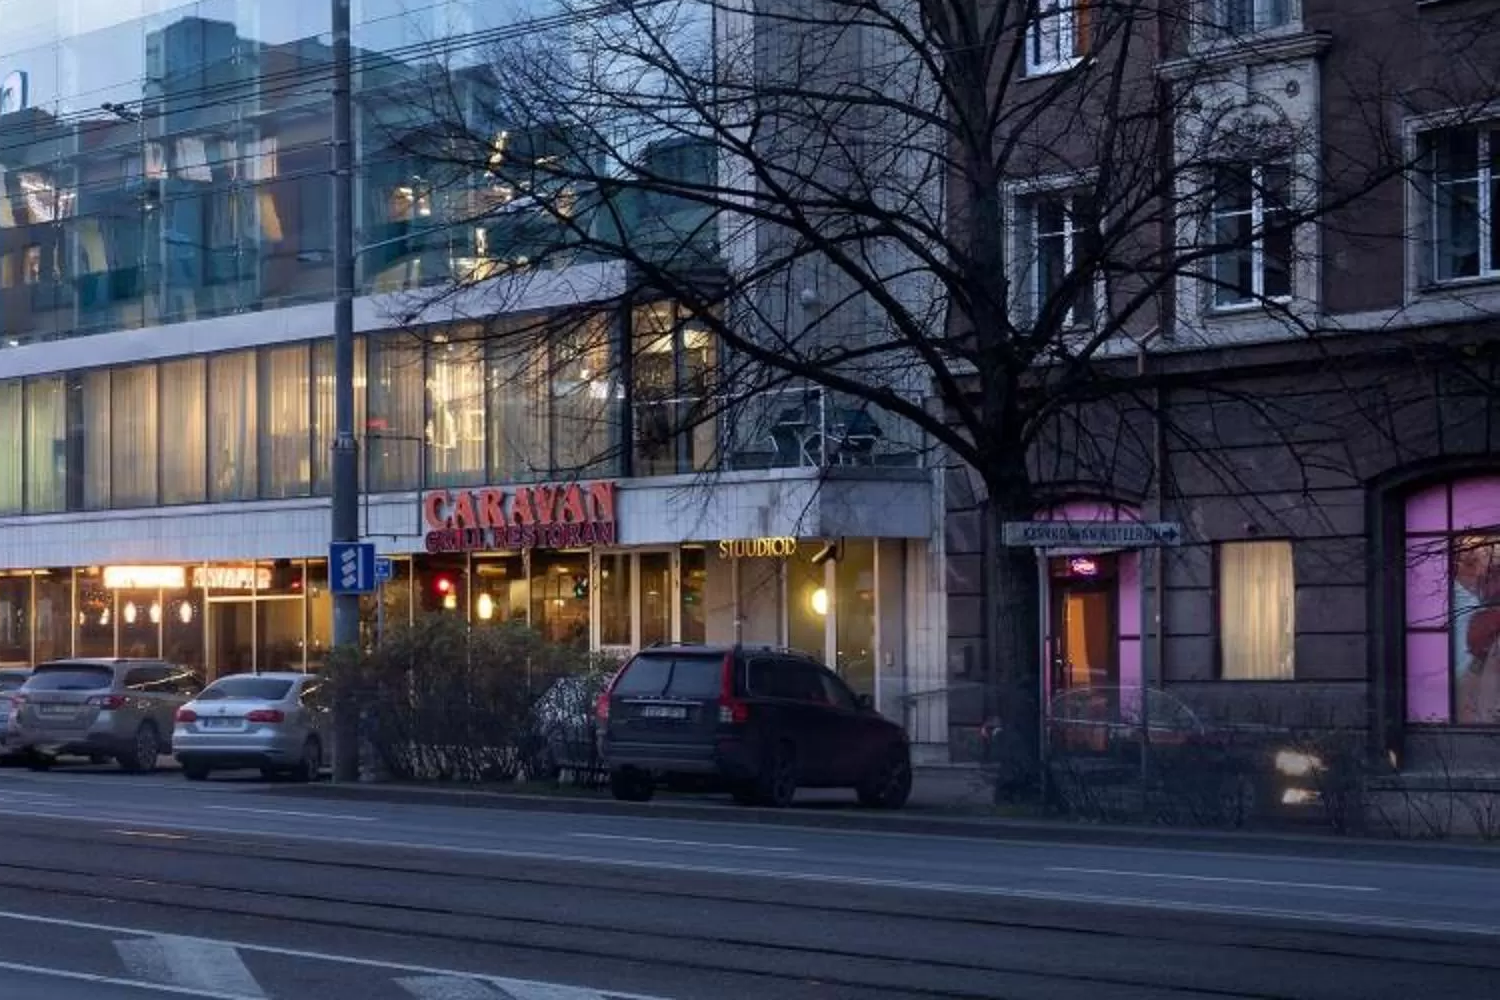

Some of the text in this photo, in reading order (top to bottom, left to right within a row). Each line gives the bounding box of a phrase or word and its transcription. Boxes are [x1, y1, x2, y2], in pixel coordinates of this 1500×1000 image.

[423, 480, 615, 529] CARAVAN
[493, 521, 614, 549] RESTORAN
[719, 536, 797, 558] STUUDIOD
